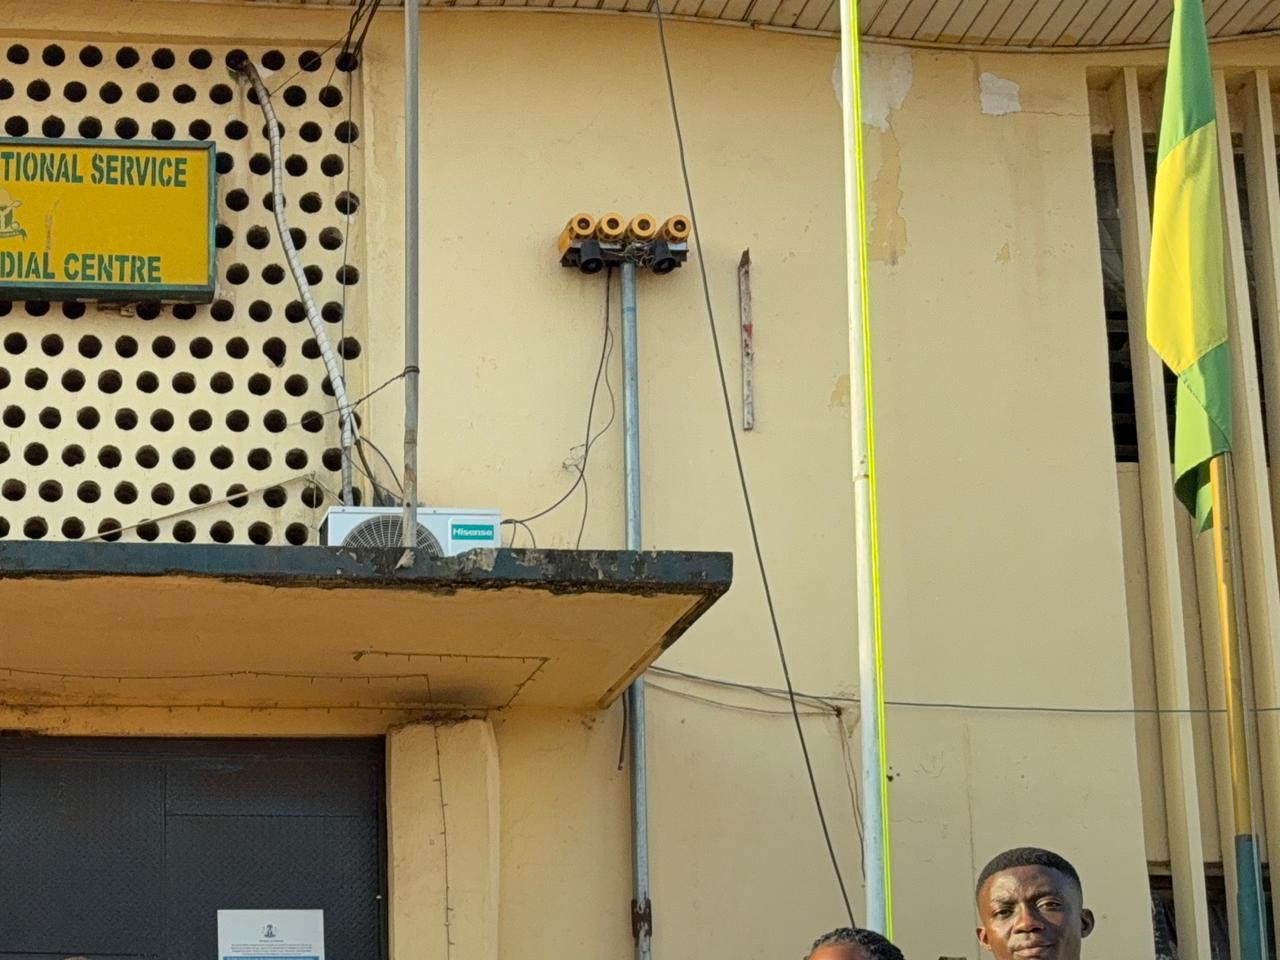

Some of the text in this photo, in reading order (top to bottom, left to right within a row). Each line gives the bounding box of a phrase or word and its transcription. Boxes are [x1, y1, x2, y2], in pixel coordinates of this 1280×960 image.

[91, 153, 188, 187] SERVICE
[63, 252, 161, 283] CENTRE
[452, 527, 493, 537] Hisense
